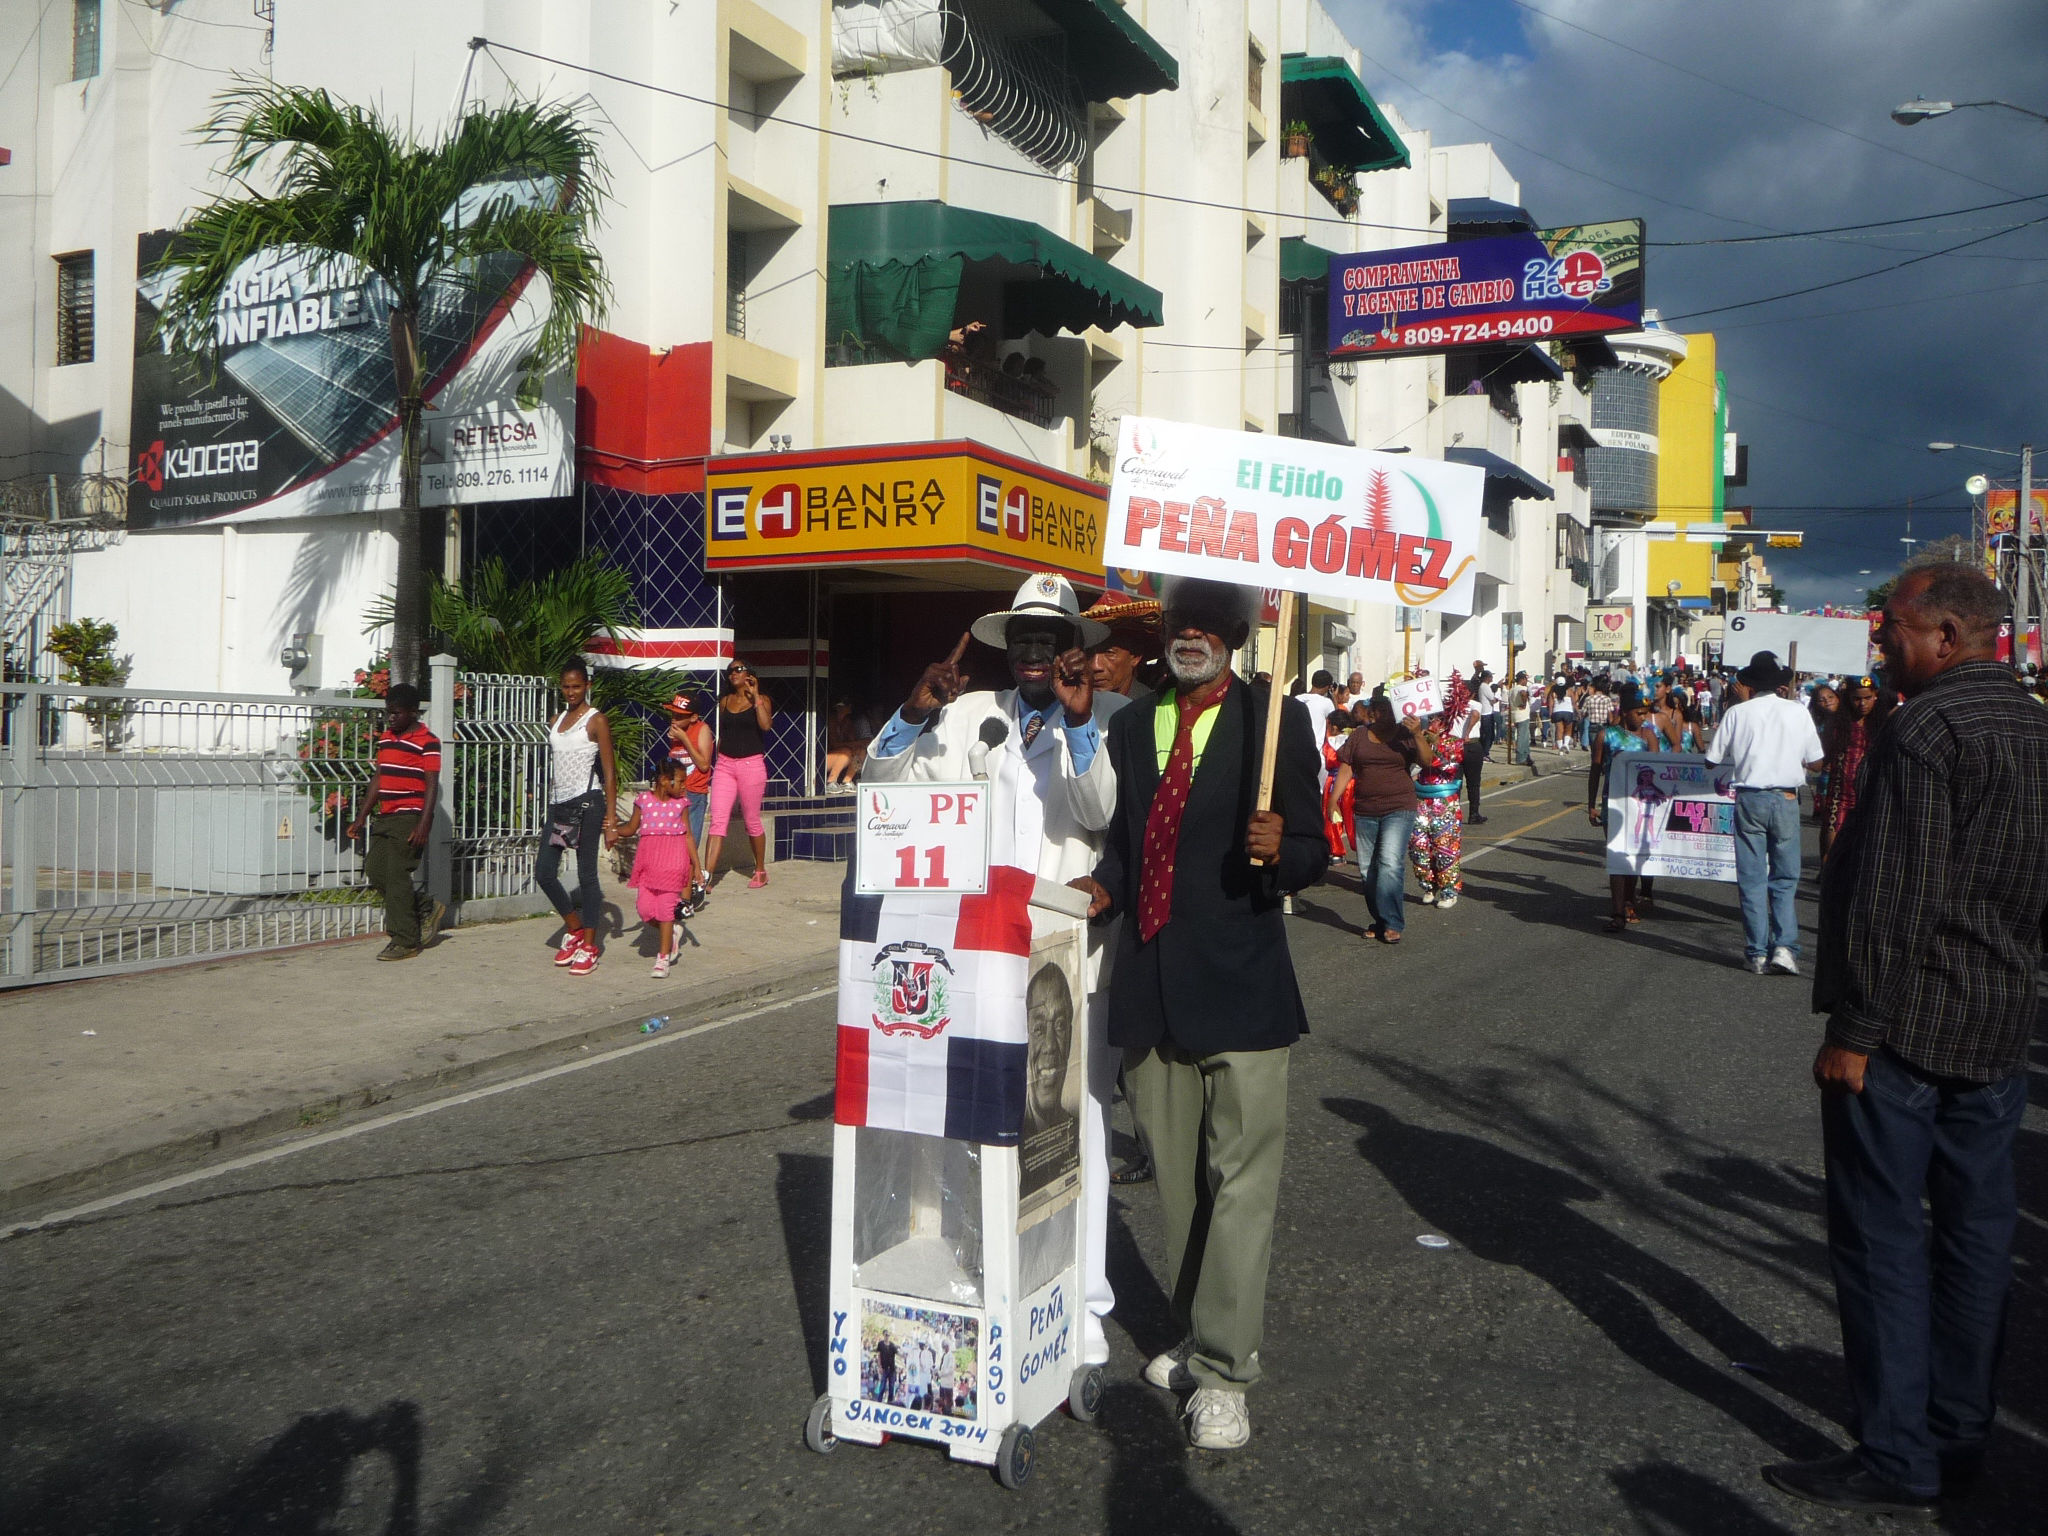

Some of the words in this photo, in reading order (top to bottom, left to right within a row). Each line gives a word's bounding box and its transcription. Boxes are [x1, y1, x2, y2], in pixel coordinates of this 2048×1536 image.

[1344, 257, 1460, 290] COMPRAVENTA
[1524, 258, 1568, 281] 24
[1344, 295, 1354, 317] Y
[1357, 288, 1419, 316] AGENTE
[1423, 285, 1445, 309] DE
[1449, 278, 1514, 307] CAMBIO
[1523, 278, 1611, 299] Horas
[184, 290, 368, 351] ONFIABLE.
[1404, 316, 1553, 345] 809-724-9400
[159, 415, 182, 432] panels
[184, 408, 235, 426] manufactured
[161, 404, 174, 415] We
[174, 399, 204, 417] proudly
[205, 396, 228, 410] install
[229, 394, 248, 407] solar
[454, 422, 537, 447] RETECSA
[165, 440, 258, 480] KYOCERA
[1121, 457, 1189, 480] Carnaval
[427, 474, 453, 490] Tel.:
[456, 472, 483, 487] 809.
[487, 469, 515, 485] 276.
[518, 466, 549, 483] 1114
[1235, 458, 1261, 490] El
[1268, 463, 1343, 501] Ejido
[150, 496, 184, 510] QUALITY
[185, 494, 211, 505] SOLAR
[213, 489, 258, 502] PRODUCTS
[807, 478, 946, 509] BANCA
[807, 501, 945, 532] HENRY
[1032, 496, 1097, 535] BANCA
[1031, 519, 1097, 555] HENRY
[1123, 495, 1260, 563] PEÑA
[1272, 514, 1453, 590] GÓMEZ
[1594, 615, 1603, 632] I
[1730, 616, 1747, 631] 6
[1416, 680, 1433, 693] CF
[867, 816, 911, 831] Carnaval
[929, 793, 978, 825] PF
[1675, 801, 1705, 817] LAS
[895, 845, 950, 887] 11
[1029, 1284, 1063, 1341] PEÑA
[1020, 1326, 1068, 1384] GOMEZ
[939, 1419, 988, 1443] 2014
